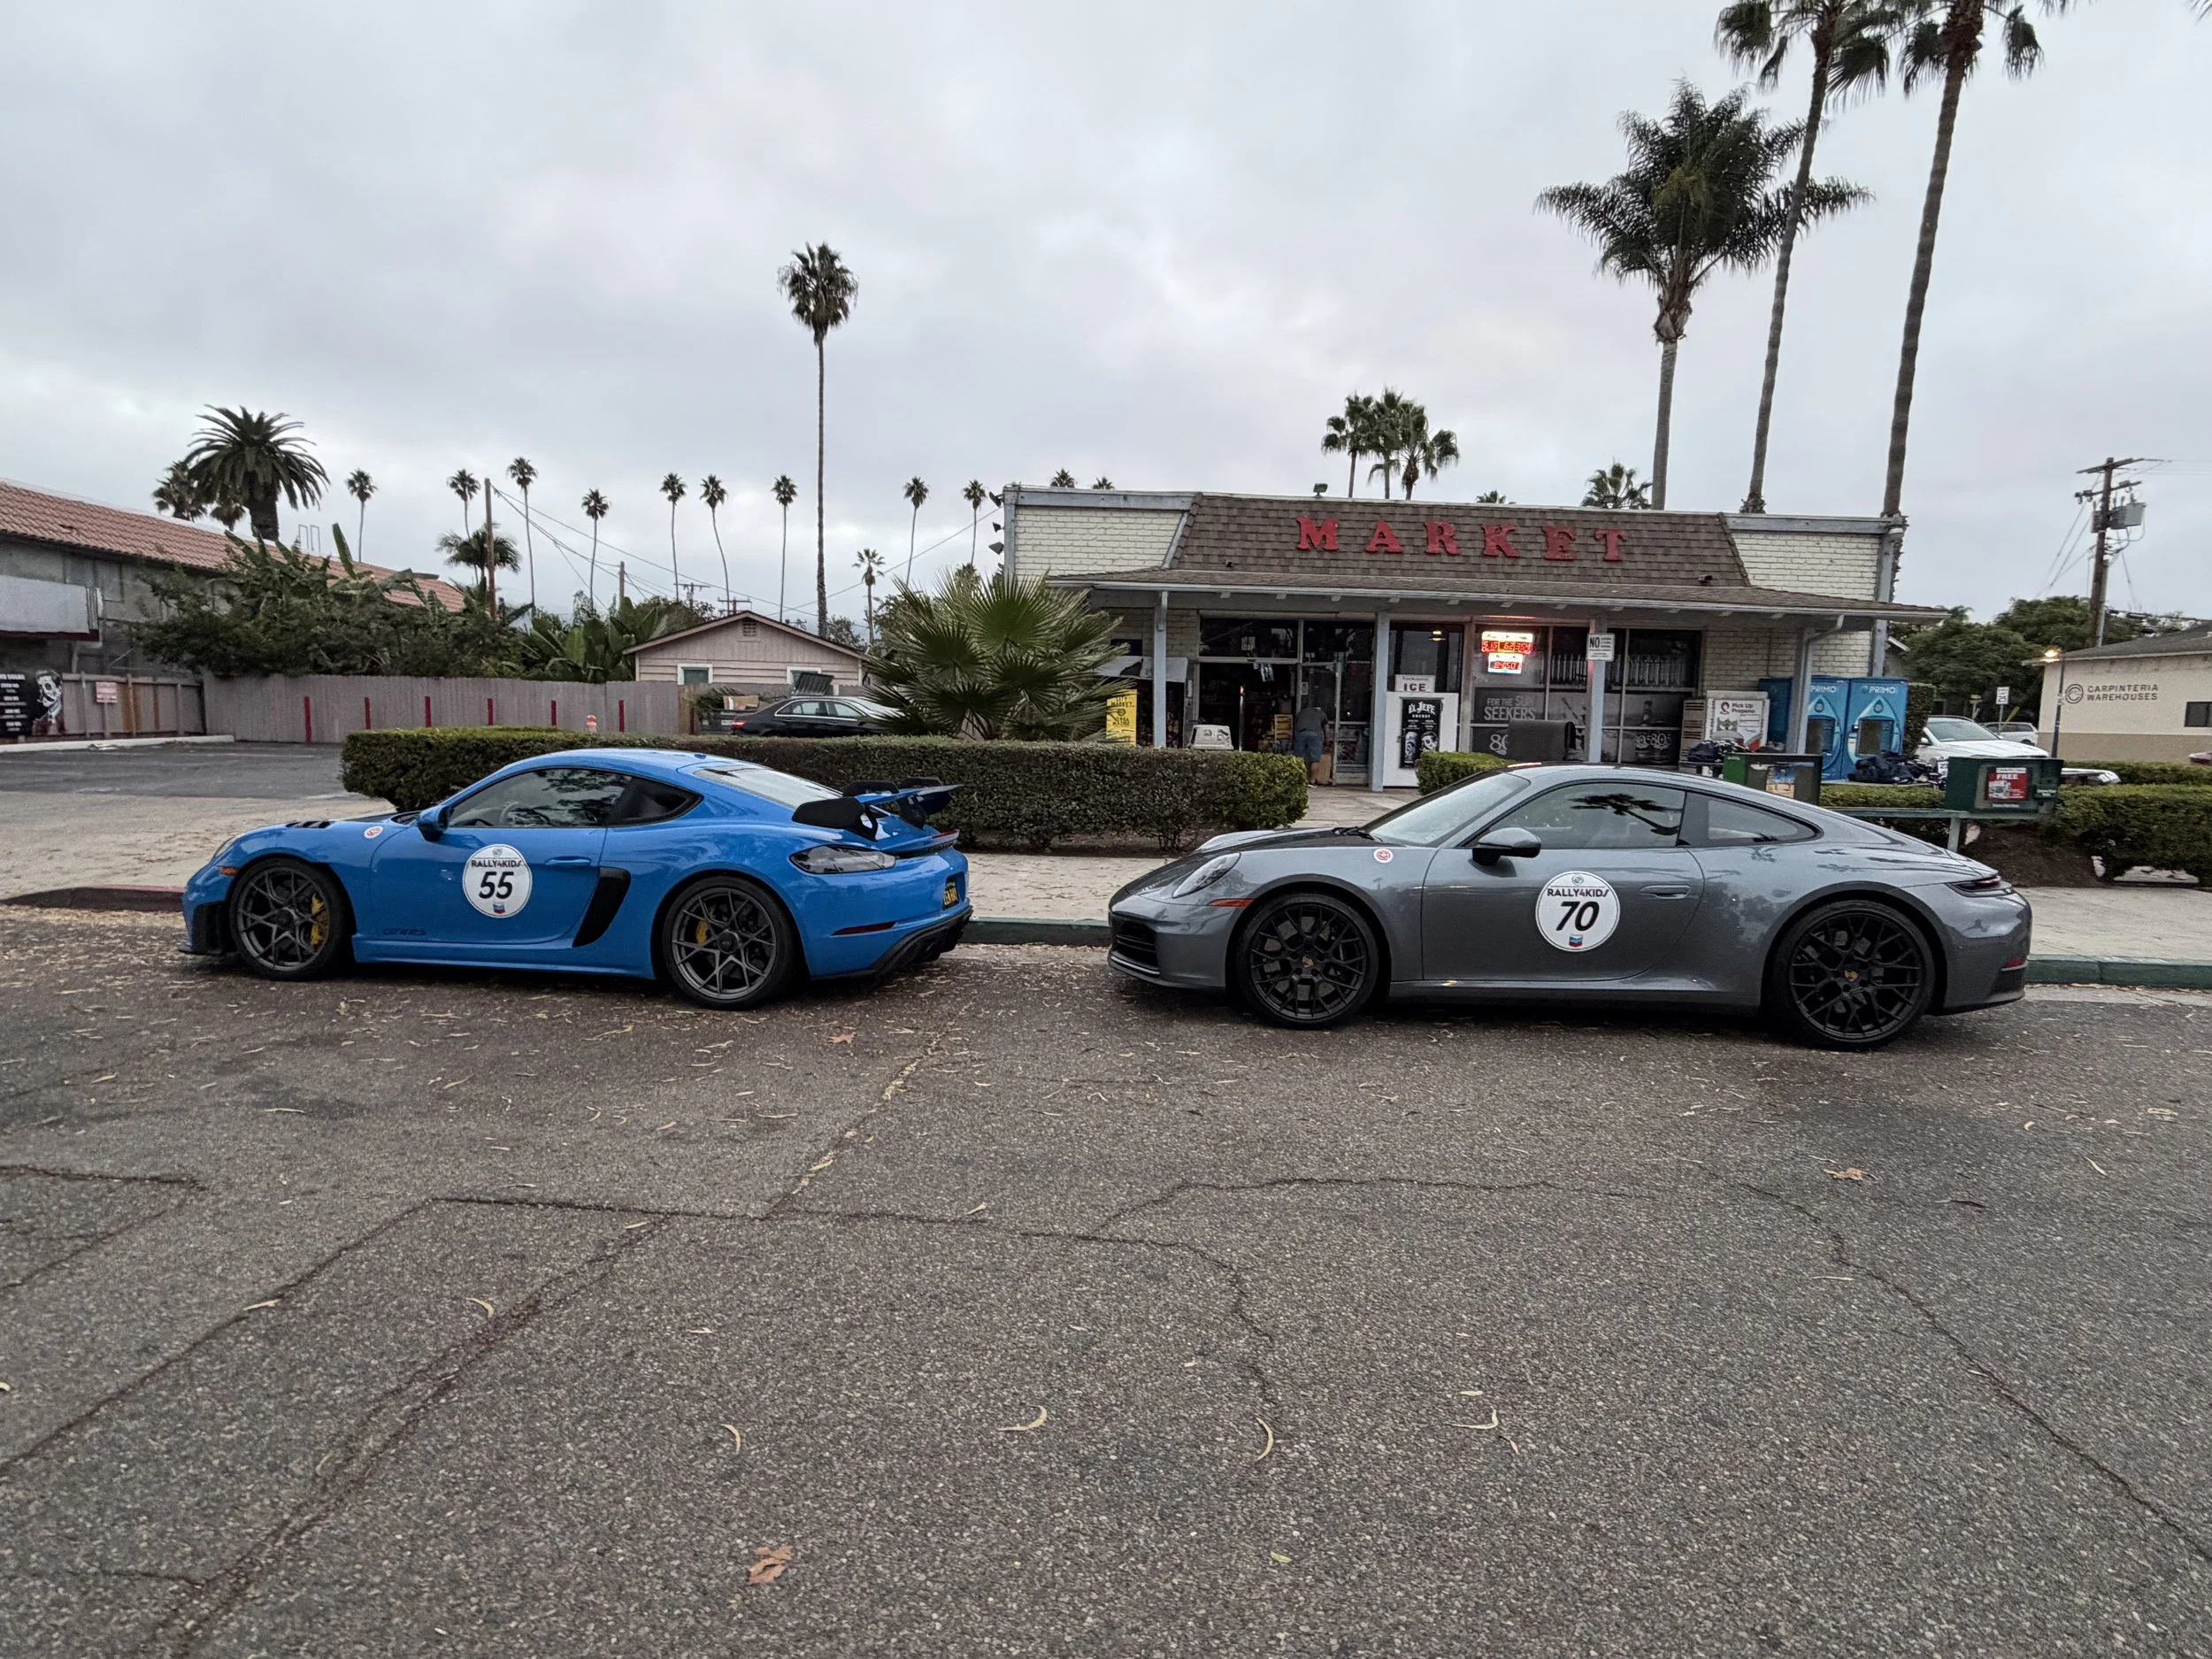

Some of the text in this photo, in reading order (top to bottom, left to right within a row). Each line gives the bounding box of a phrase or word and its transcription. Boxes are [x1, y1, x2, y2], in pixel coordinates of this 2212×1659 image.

[1296, 516, 1627, 561] MARKET
[1589, 637, 1600, 648] NO
[1484, 707, 1536, 720] SEEKERS
[479, 871, 514, 899] 55
[1547, 888, 1609, 897] RALLY4KIDS
[1555, 901, 1600, 932] 70
